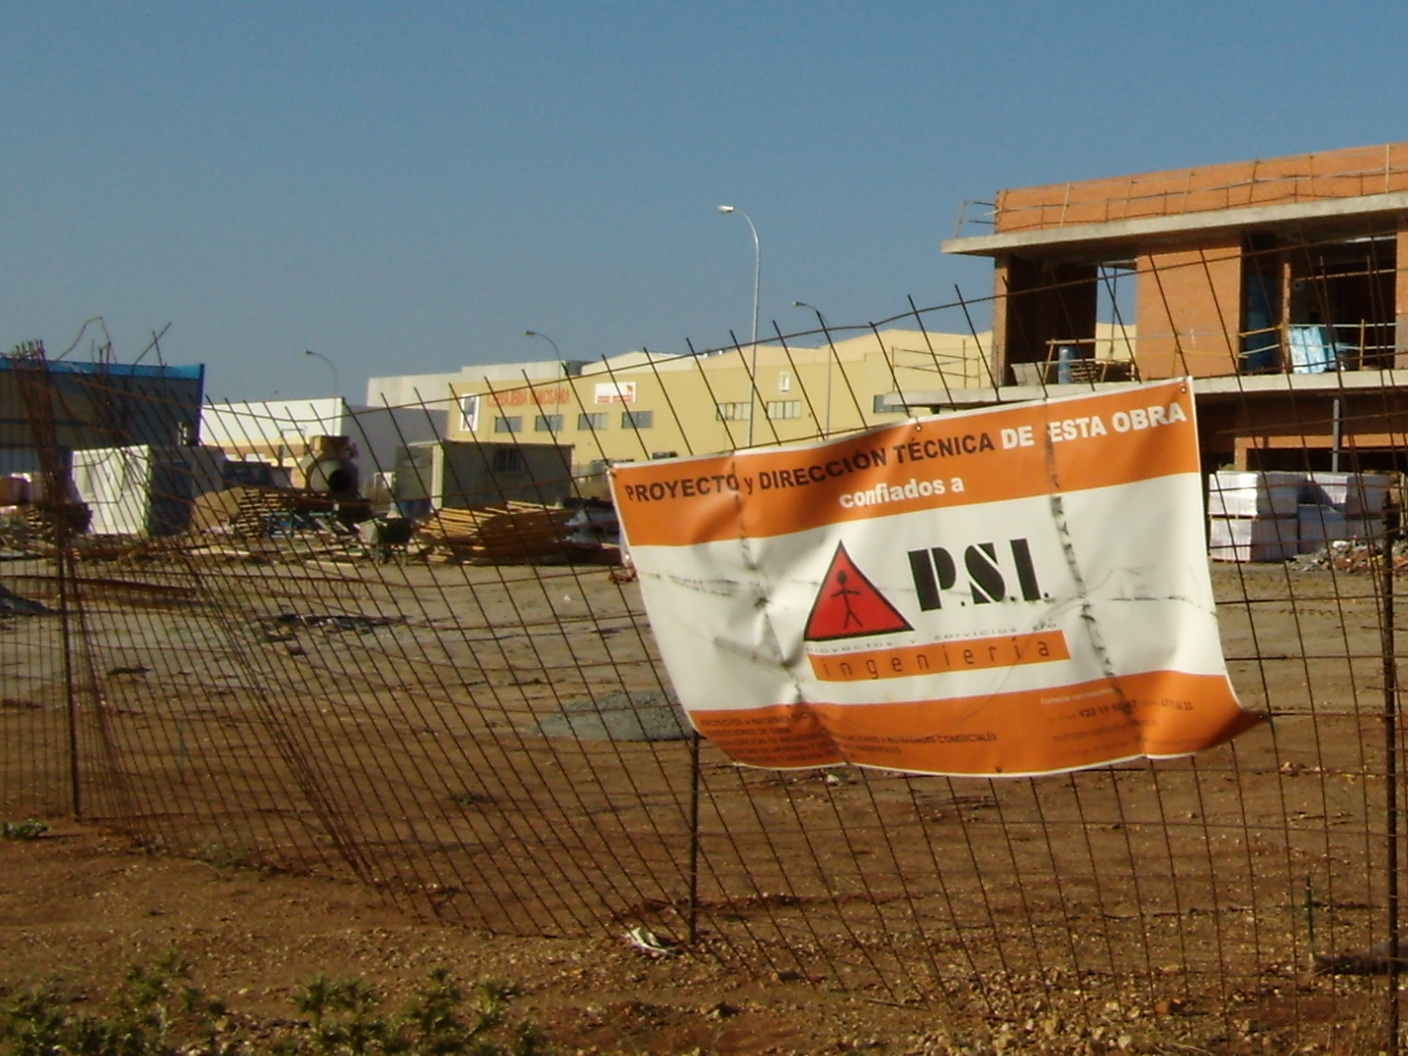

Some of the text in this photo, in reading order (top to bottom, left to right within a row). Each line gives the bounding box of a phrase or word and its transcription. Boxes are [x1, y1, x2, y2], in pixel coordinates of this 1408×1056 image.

[625, 401, 1188, 502] PROYECTO y DIRECCIÓN TÉCNICA DE ESTA OBRA
[839, 476, 965, 509] confiados a
[820, 636, 1051, 680] ingeniería
